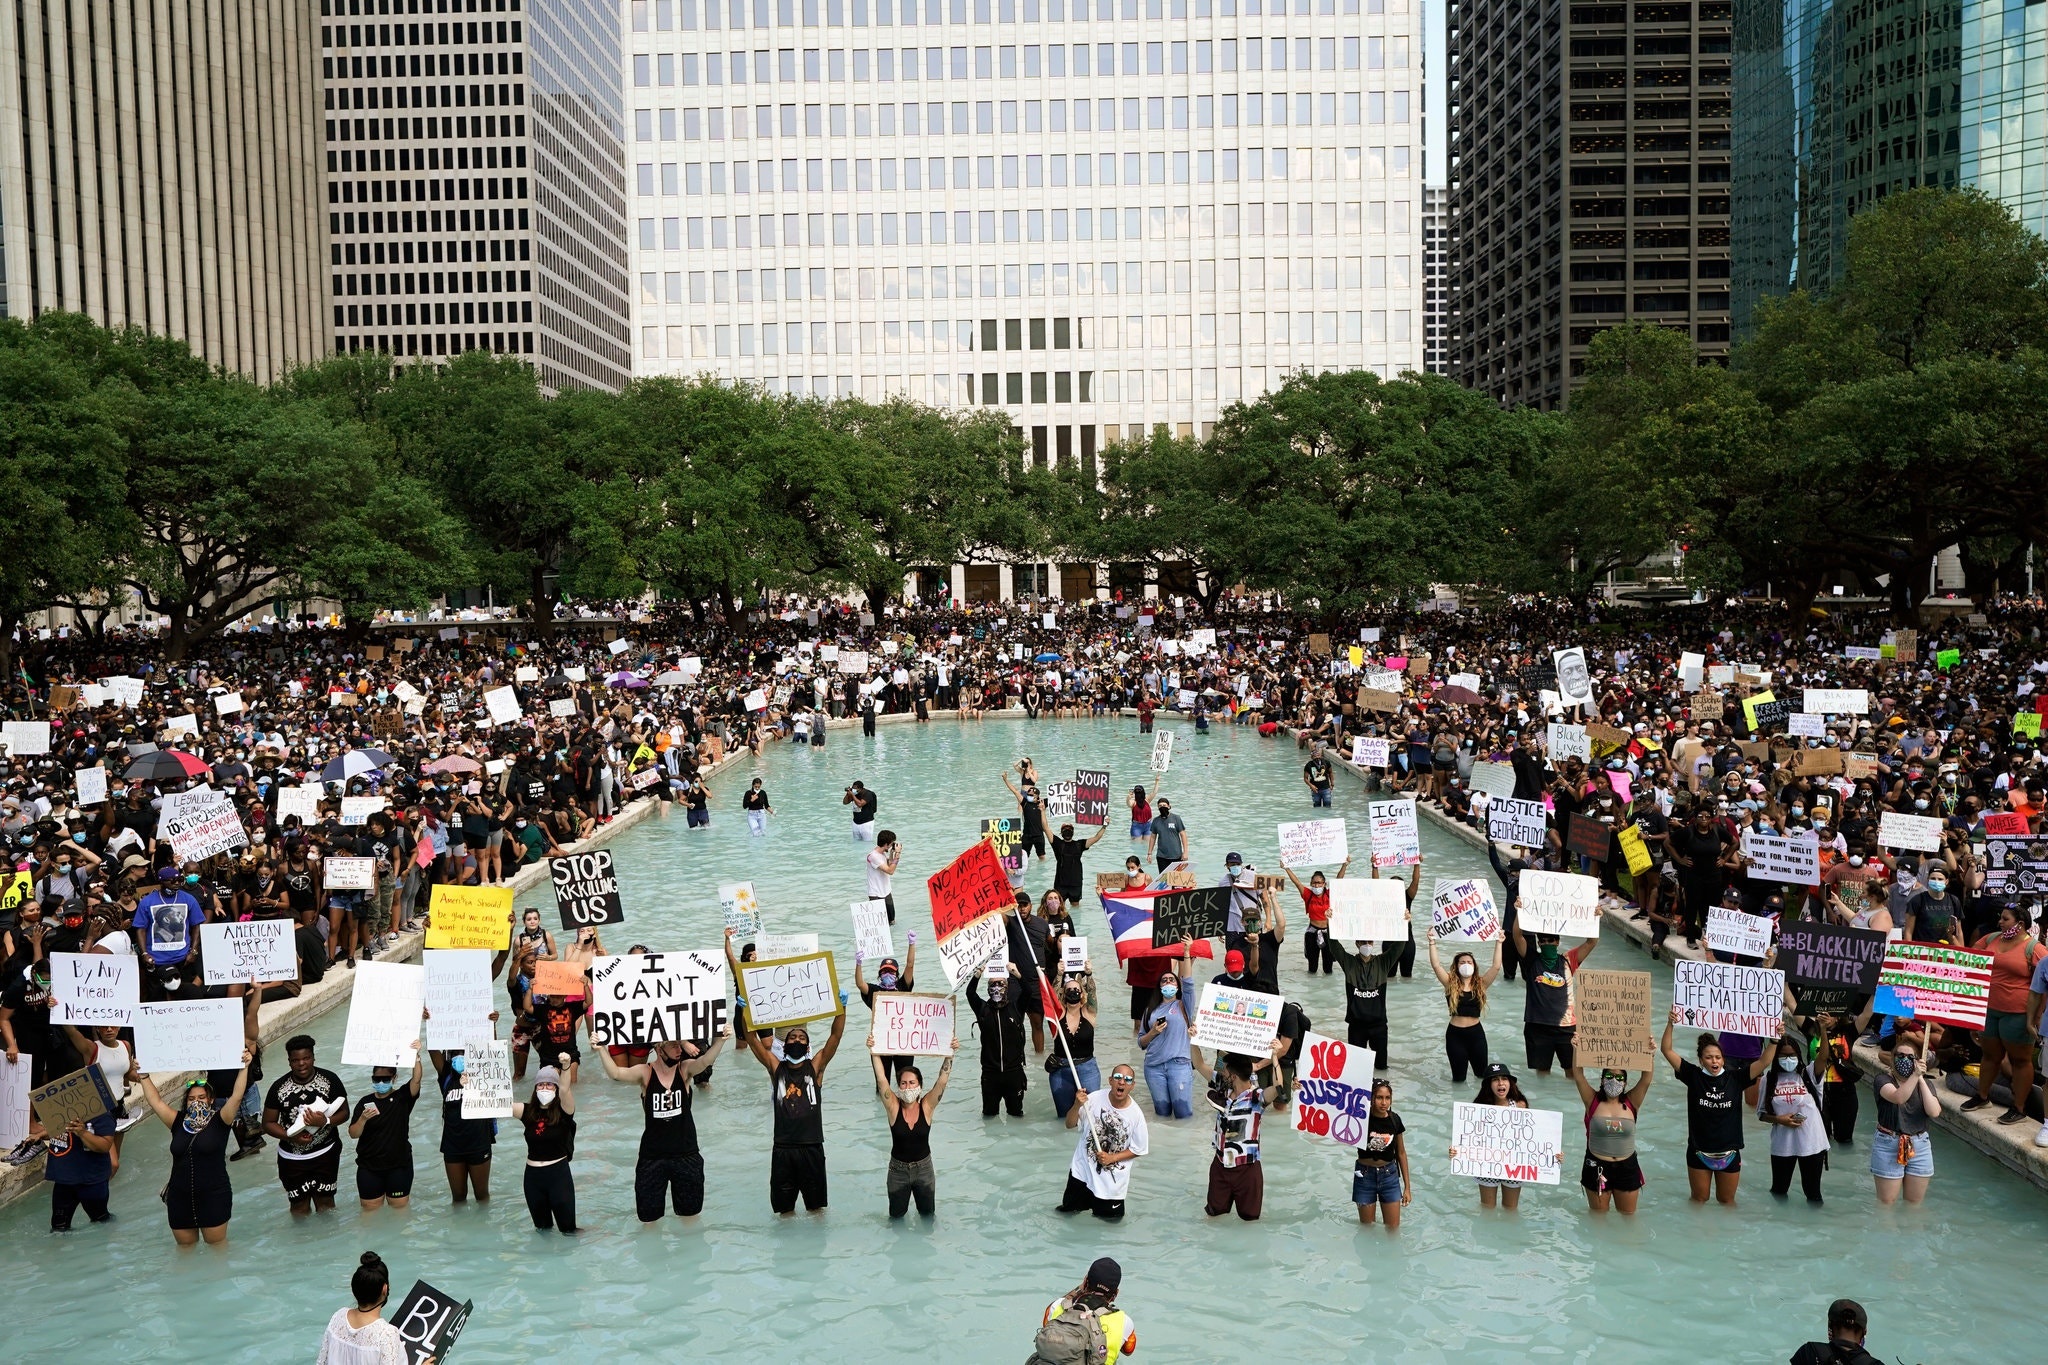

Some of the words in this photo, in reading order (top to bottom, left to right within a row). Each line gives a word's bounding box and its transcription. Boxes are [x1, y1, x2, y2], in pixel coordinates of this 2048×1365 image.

[1755, 707, 1782, 717] BLACK
[1158, 732, 1168, 743] NO
[1361, 739, 1387, 748] BLACK
[1556, 726, 1585, 743] Black
[1154, 752, 1164, 762] NO
[1360, 748, 1382, 757] LIVES
[1556, 742, 1583, 754] Lives
[1354, 755, 1384, 766] MATTER
[1077, 771, 1108, 788] YOUR
[174, 793, 215, 807] LEGALIZE
[1077, 788, 1105, 799] PAIN
[1077, 801, 1086, 813] IS
[1091, 802, 1108, 815] MY
[1372, 806, 1387, 818] I
[1490, 797, 1544, 817] JUSTICE
[172, 831, 193, 847] HAVE
[194, 825, 209, 837] HAD
[210, 811, 239, 831] ENOUGH
[344, 815, 365, 824] FREE
[1077, 816, 1102, 824] PAIN
[1511, 814, 1519, 824] 4
[200, 844, 221, 858] LIVES
[222, 831, 247, 850] MATTER
[1750, 838, 1765, 846] HOW
[1769, 840, 1787, 848] MANY
[1790, 846, 1805, 854] WILL
[551, 851, 611, 885] STOP
[1752, 851, 1766, 859] TAKE
[1770, 853, 1782, 861] FOR
[1784, 855, 1802, 863] THEM
[1805, 858, 1813, 866] TO
[932, 869, 951, 897] NO
[956, 846, 990, 878] MORE
[1750, 862, 1766, 871] STOP
[1770, 865, 1792, 874] KILLING
[1795, 868, 1813, 877] US??
[555, 876, 618, 902] KKKILLING
[944, 864, 995, 905] BLOOD
[1435, 893, 1451, 908] THE
[1454, 879, 1476, 896] TIME
[1530, 874, 1564, 897] GOD
[571, 896, 608, 924] US
[860, 904, 873, 912] NO
[1159, 891, 1220, 919] BLACK
[1433, 910, 1442, 922] IS
[1443, 890, 1482, 918] ALWAYS
[1522, 898, 1564, 918] RACISM
[854, 912, 888, 928] FREEDOM
[1169, 914, 1209, 927] LIVES
[1434, 916, 1462, 938] RIGHT
[1465, 908, 1479, 920] TO
[1482, 900, 1491, 911] DO
[1463, 917, 1485, 937] WHAT
[1488, 911, 1495, 920] IS
[1542, 919, 1568, 933] MIX
[1709, 908, 1732, 921] BLACK
[1735, 910, 1758, 929] PEOPLE
[224, 924, 281, 939] AMERICAN
[940, 932, 960, 956] WE
[964, 913, 997, 942] WANT
[1155, 920, 1225, 947] MATTER
[1478, 917, 1500, 942] RIGHT
[233, 938, 277, 954] HORROR
[450, 937, 465, 945] NOT
[1707, 932, 1739, 947] PROTECT
[1744, 938, 1766, 953] THEM
[641, 954, 665, 974] I
[689, 952, 722, 976] Mama!
[1887, 945, 1923, 959] NEXT
[1927, 947, 1952, 963] TIME
[73, 960, 92, 984] By
[98, 960, 122, 985] Any
[208, 970, 225, 980] The
[595, 957, 621, 982] Mama
[748, 968, 767, 993] I
[773, 959, 823, 988] CAN'T
[1676, 960, 1730, 989] GEORGE
[1733, 966, 1784, 995] FLOYD'S
[1796, 954, 1864, 985] MATTER
[77, 984, 114, 999] means
[613, 972, 699, 1001] CAN'T
[1800, 989, 1813, 1001] AM
[1821, 990, 1847, 1001] NEXT?
[749, 980, 831, 1017] BREATH
[1675, 984, 1706, 1008] LIFE
[1710, 987, 1784, 1018] MATTERED
[65, 1003, 132, 1024] Necessary
[140, 1006, 173, 1016] There
[180, 1005, 210, 1013] comes
[882, 1001, 905, 1016] TU
[913, 1003, 946, 1017] LUCHA
[152, 1022, 179, 1031] time
[186, 1017, 216, 1028] when
[595, 999, 727, 1047] BREATHE
[891, 1017, 903, 1029] ES
[914, 1019, 928, 1029] MI
[1712, 1011, 1738, 1031] LIVES
[1741, 1014, 1781, 1039] MATTER
[487, 1043, 505, 1058] lives
[887, 1031, 939, 1050] LUCHA
[154, 1052, 223, 1068] Betrayal
[1310, 1041, 1347, 1080] NO
[483, 1067, 510, 1080] BLACK
[34, 1073, 89, 1102] Large
[653, 1090, 681, 1110] BETO
[1700, 1099, 1732, 1108] BREATHE
[1297, 1105, 1330, 1136] NO
[1460, 1106, 1475, 1120] IT
[1481, 1108, 1497, 1123] IS
[1502, 1110, 1535, 1126] OUR
[1464, 1120, 1507, 1138] DUTY
[1511, 1124, 1534, 1140] TO
[1459, 1134, 1496, 1149] FIGHT
[1500, 1138, 1522, 1151] FOR
[1527, 1140, 1554, 1155] OUR
[1453, 1158, 1483, 1176] DUTY
[1489, 1162, 1502, 1177] TO
[1505, 1164, 1537, 1181] WIN
